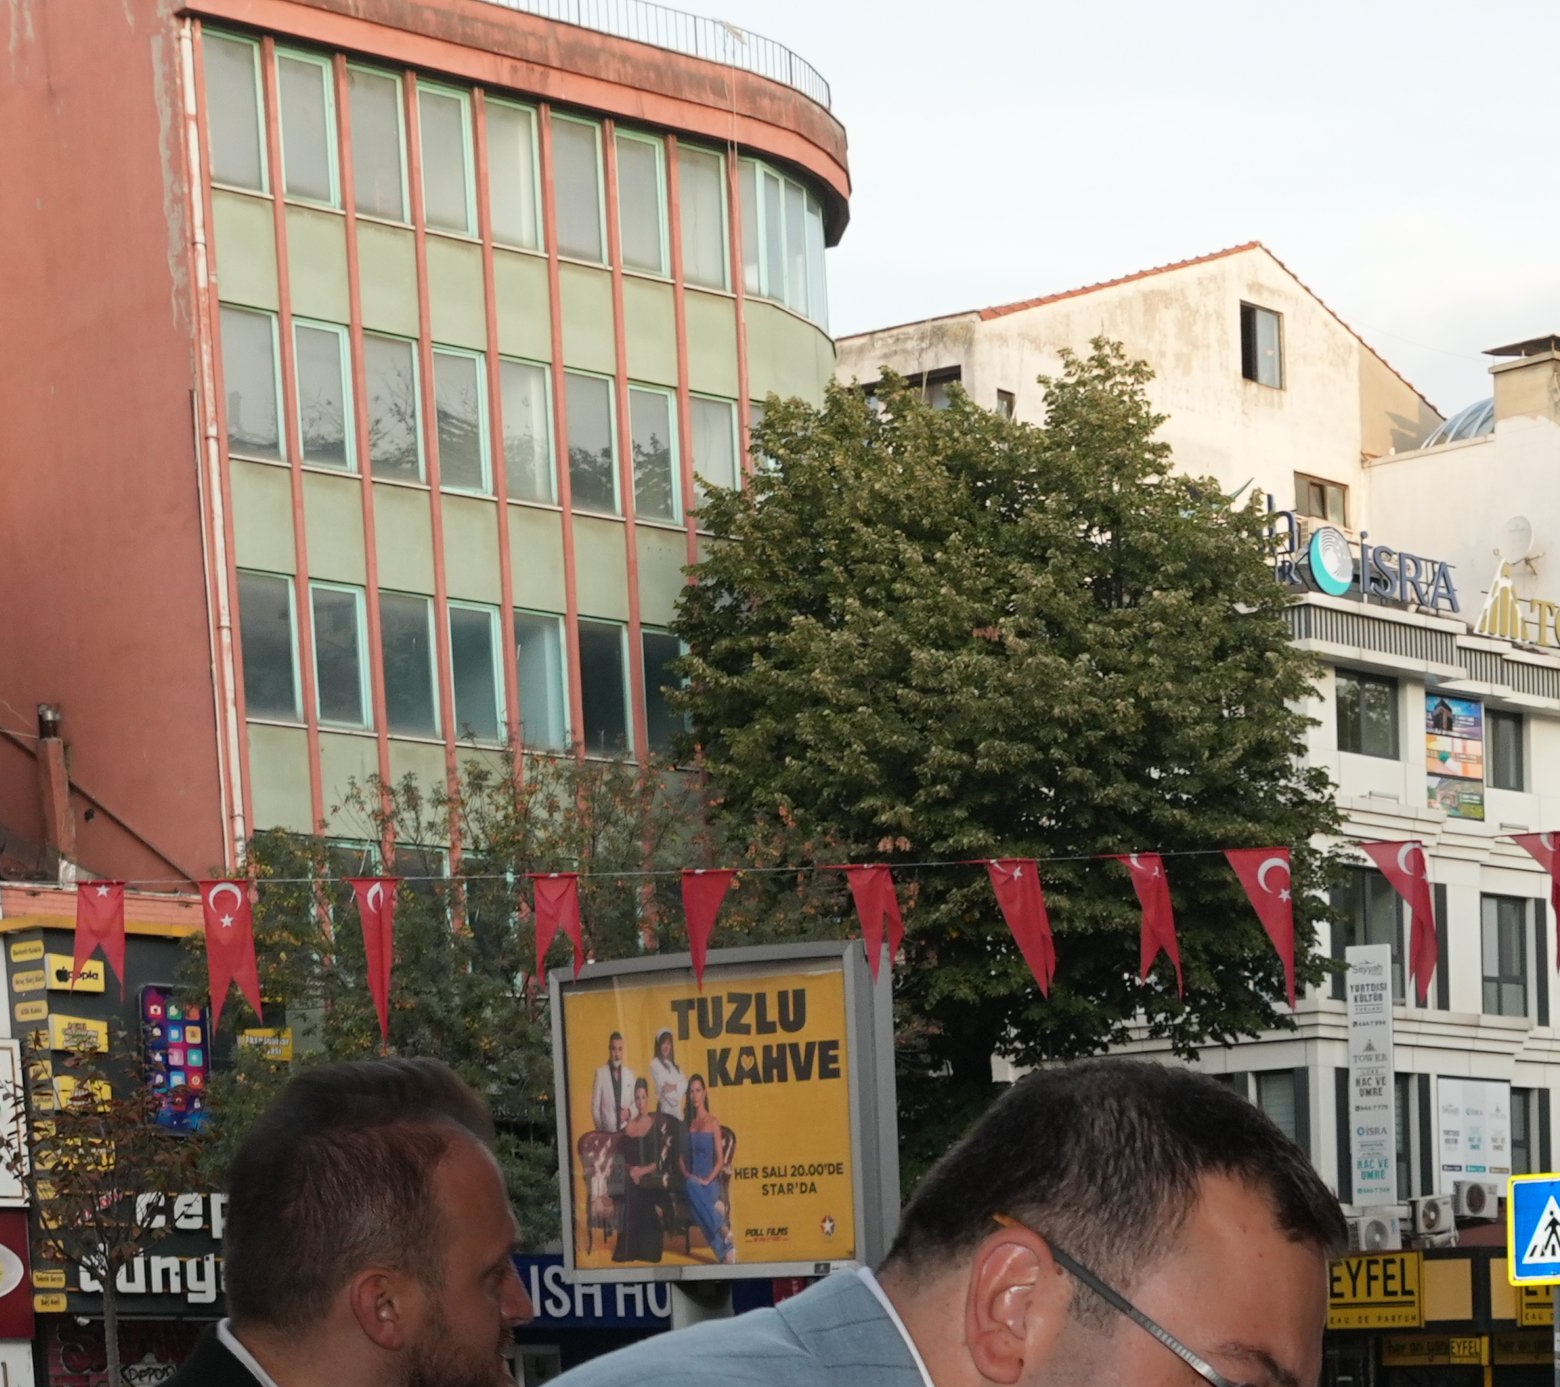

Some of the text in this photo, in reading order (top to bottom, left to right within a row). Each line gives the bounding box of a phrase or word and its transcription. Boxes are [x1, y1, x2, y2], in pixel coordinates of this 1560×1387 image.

[1360, 531, 1461, 613] İSRA
[670, 987, 807, 1042] TUZLU
[706, 1039, 842, 1088] KAHVE
[1352, 1054, 1388, 1063] TOWER
[734, 1162, 845, 1181] HER SALI 20.00'DE
[761, 1182, 818, 1197] STAR'DA
[744, 1227, 764, 1238] POLL
[79, 1242, 227, 1304] düny
[1329, 1258, 1415, 1299] EYFEL
[1357, 1315, 1370, 1324] DE
[1376, 1313, 1418, 1324] PARFUM
[1450, 1340, 1480, 1357] EYFEL
